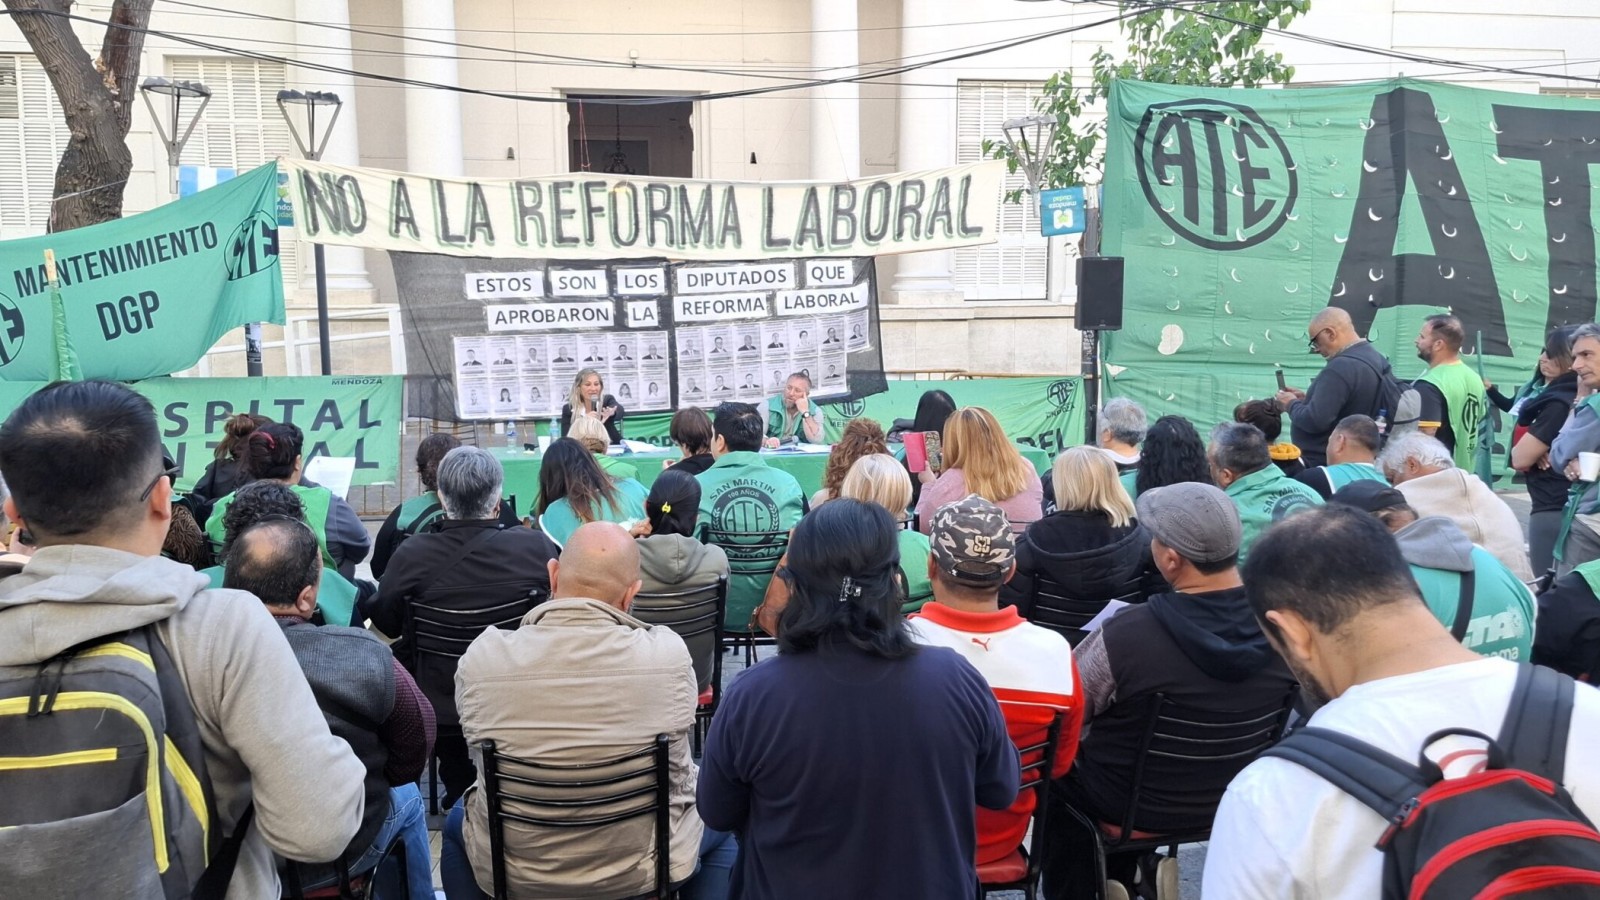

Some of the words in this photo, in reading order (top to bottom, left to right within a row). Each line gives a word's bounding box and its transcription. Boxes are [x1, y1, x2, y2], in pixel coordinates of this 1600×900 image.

[1152, 108, 1278, 236] ATE
[297, 169, 367, 238] NO
[390, 177, 420, 239] A
[431, 178, 496, 247] LA
[511, 181, 743, 251] REFORMA
[762, 174, 983, 252] LABORAL
[13, 221, 218, 298] MANTENIMIENTO
[476, 277, 532, 293] ESTOS
[558, 275, 597, 290] SON
[624, 273, 658, 289] LOS
[686, 268, 788, 288] DIPUTADOS
[811, 265, 846, 280] QUE
[96, 290, 161, 342] DGP
[495, 306, 610, 326] APROBARON
[632, 306, 655, 321] LA
[682, 296, 765, 315] REFORMA
[784, 291, 860, 310] LABORAL
[163, 398, 383, 438] SPITAL
[709, 482, 731, 501] SAN
[732, 478, 775, 494] MARTIN
[727, 491, 739, 499] 100
[740, 488, 761, 498] AÑOS
[1263, 493, 1278, 514] SAN
[724, 500, 766, 538] ATE
